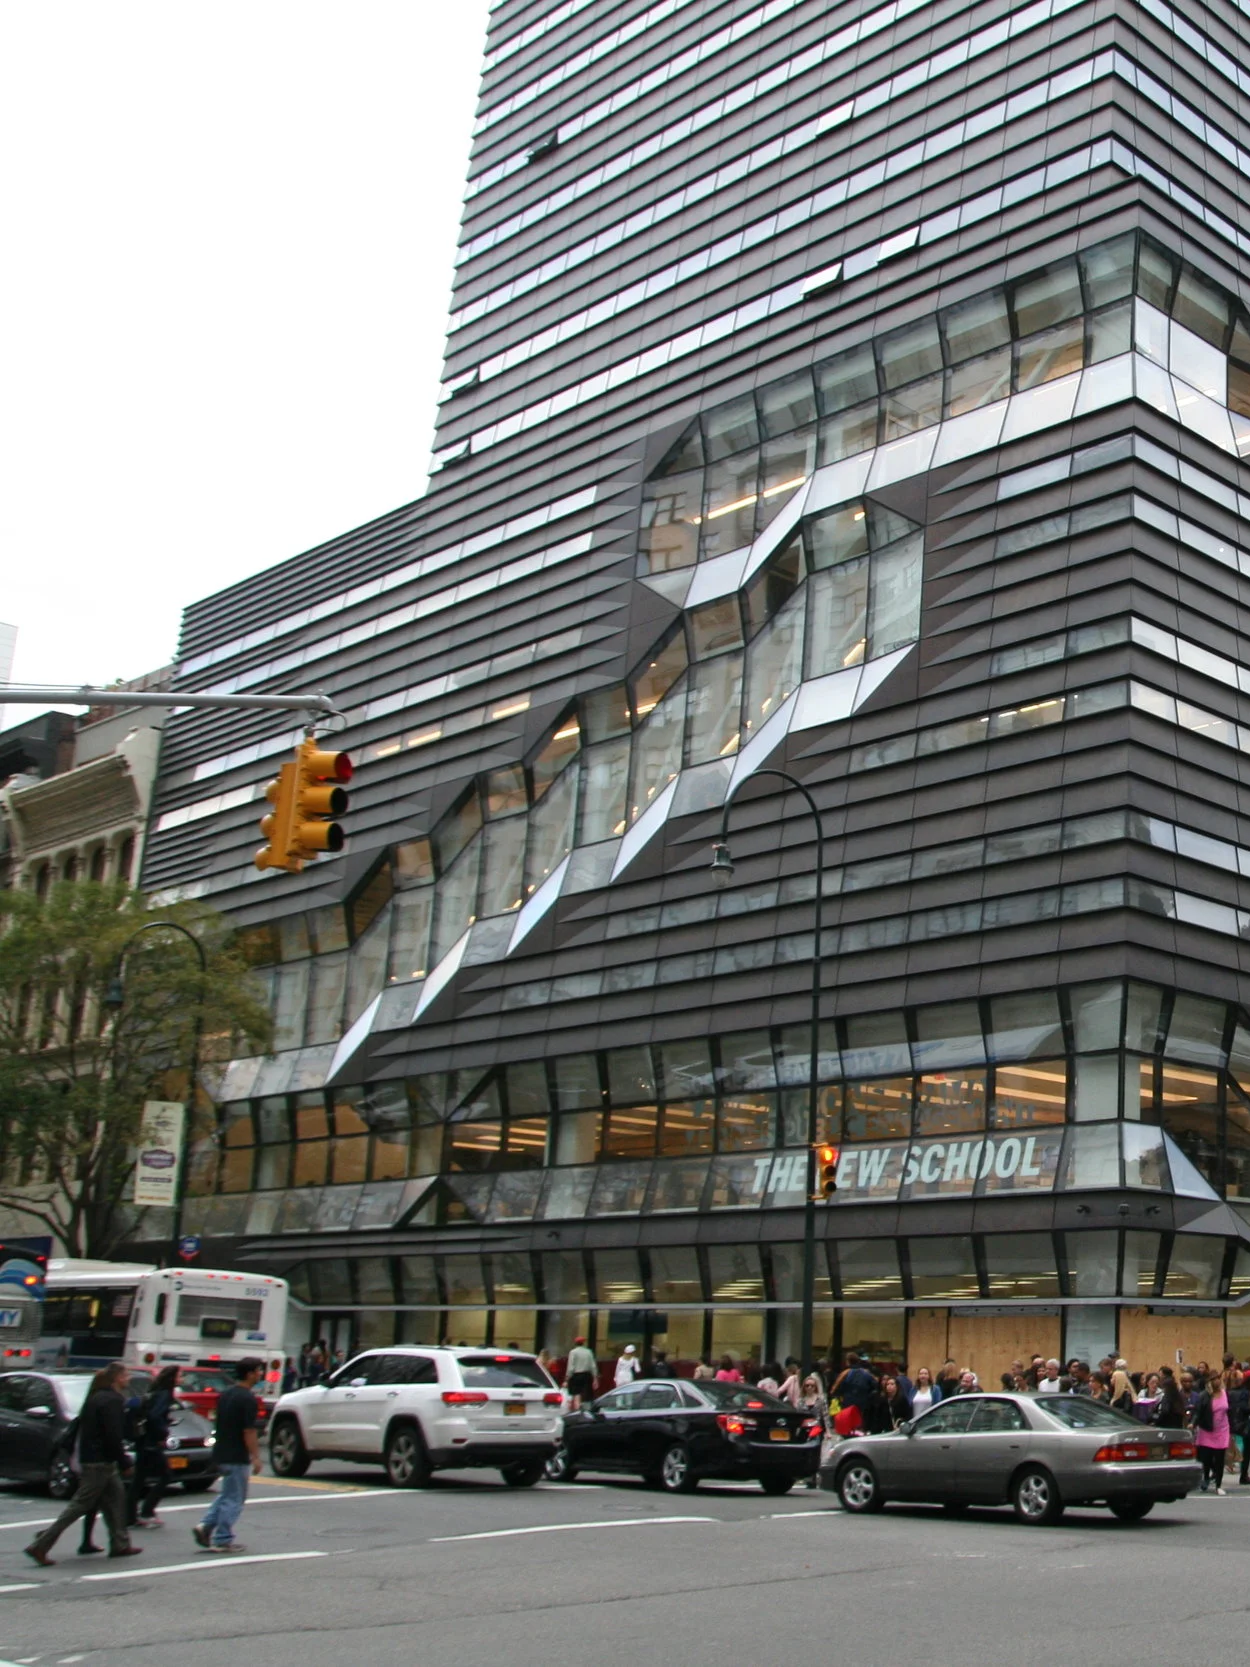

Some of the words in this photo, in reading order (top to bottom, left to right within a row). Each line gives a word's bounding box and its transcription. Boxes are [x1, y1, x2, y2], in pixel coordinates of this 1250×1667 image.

[751, 1155, 808, 1194] THE
[814, 1148, 891, 1191] EW
[897, 1136, 1041, 1186] SCHOOL
